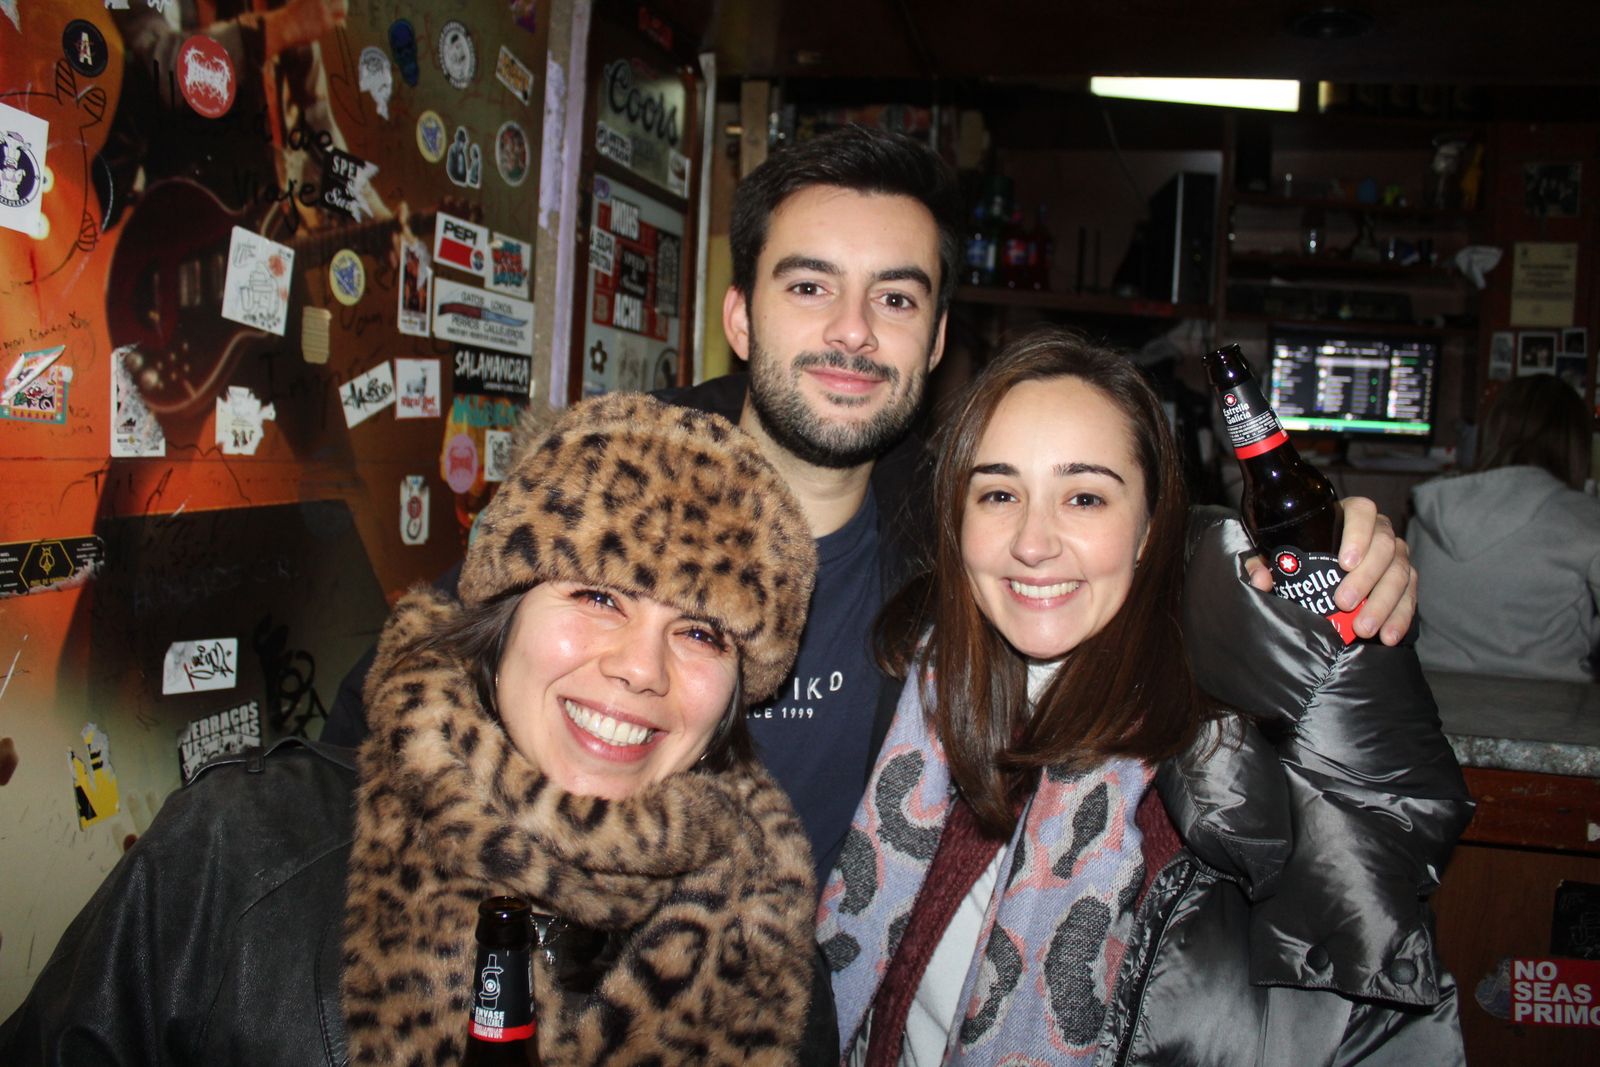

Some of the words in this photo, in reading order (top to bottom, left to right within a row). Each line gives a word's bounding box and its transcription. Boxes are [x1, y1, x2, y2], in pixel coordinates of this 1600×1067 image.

[443, 219, 478, 246] PEPI
[454, 349, 530, 387] SALAMANDRA
[1222, 402, 1250, 417] Estrella
[781, 706, 814, 719] 1999
[1514, 960, 1558, 982] NO
[1513, 981, 1593, 1005] SEAS
[475, 1006, 505, 1020] ENVASE
